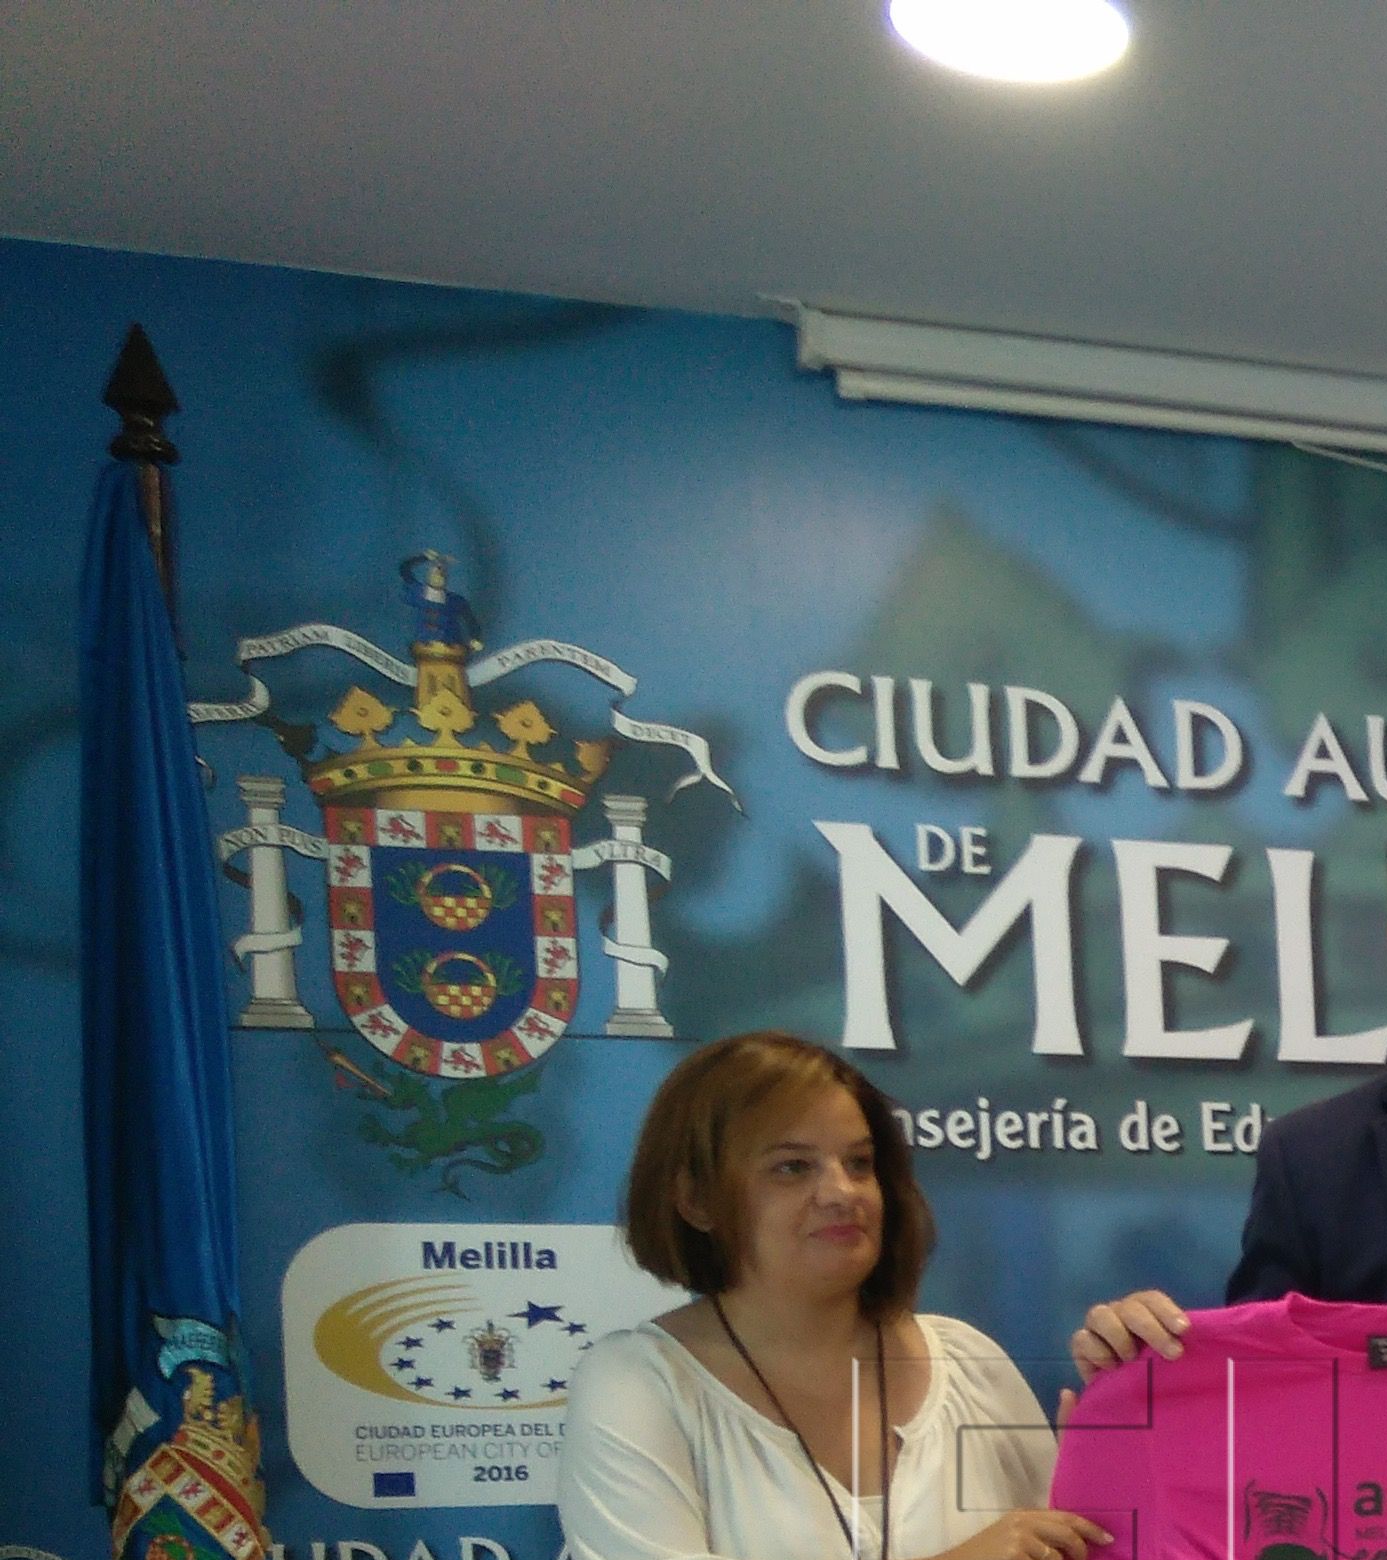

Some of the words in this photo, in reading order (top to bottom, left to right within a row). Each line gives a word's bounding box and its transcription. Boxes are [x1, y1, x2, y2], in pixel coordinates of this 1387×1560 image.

[784, 671, 1243, 792] CIUDAD
[916, 824, 992, 876] DE
[891, 1097, 1099, 1161] nsejería
[1119, 1099, 1184, 1153] de
[422, 1241, 558, 1270] Melilla
[355, 1425, 426, 1440] CIUDAD
[431, 1424, 516, 1439] EUROPEA
[520, 1423, 552, 1437] DEL
[355, 1442, 477, 1462] EUROPEAN
[483, 1441, 530, 1460] CITY
[473, 1464, 530, 1483] 2016
